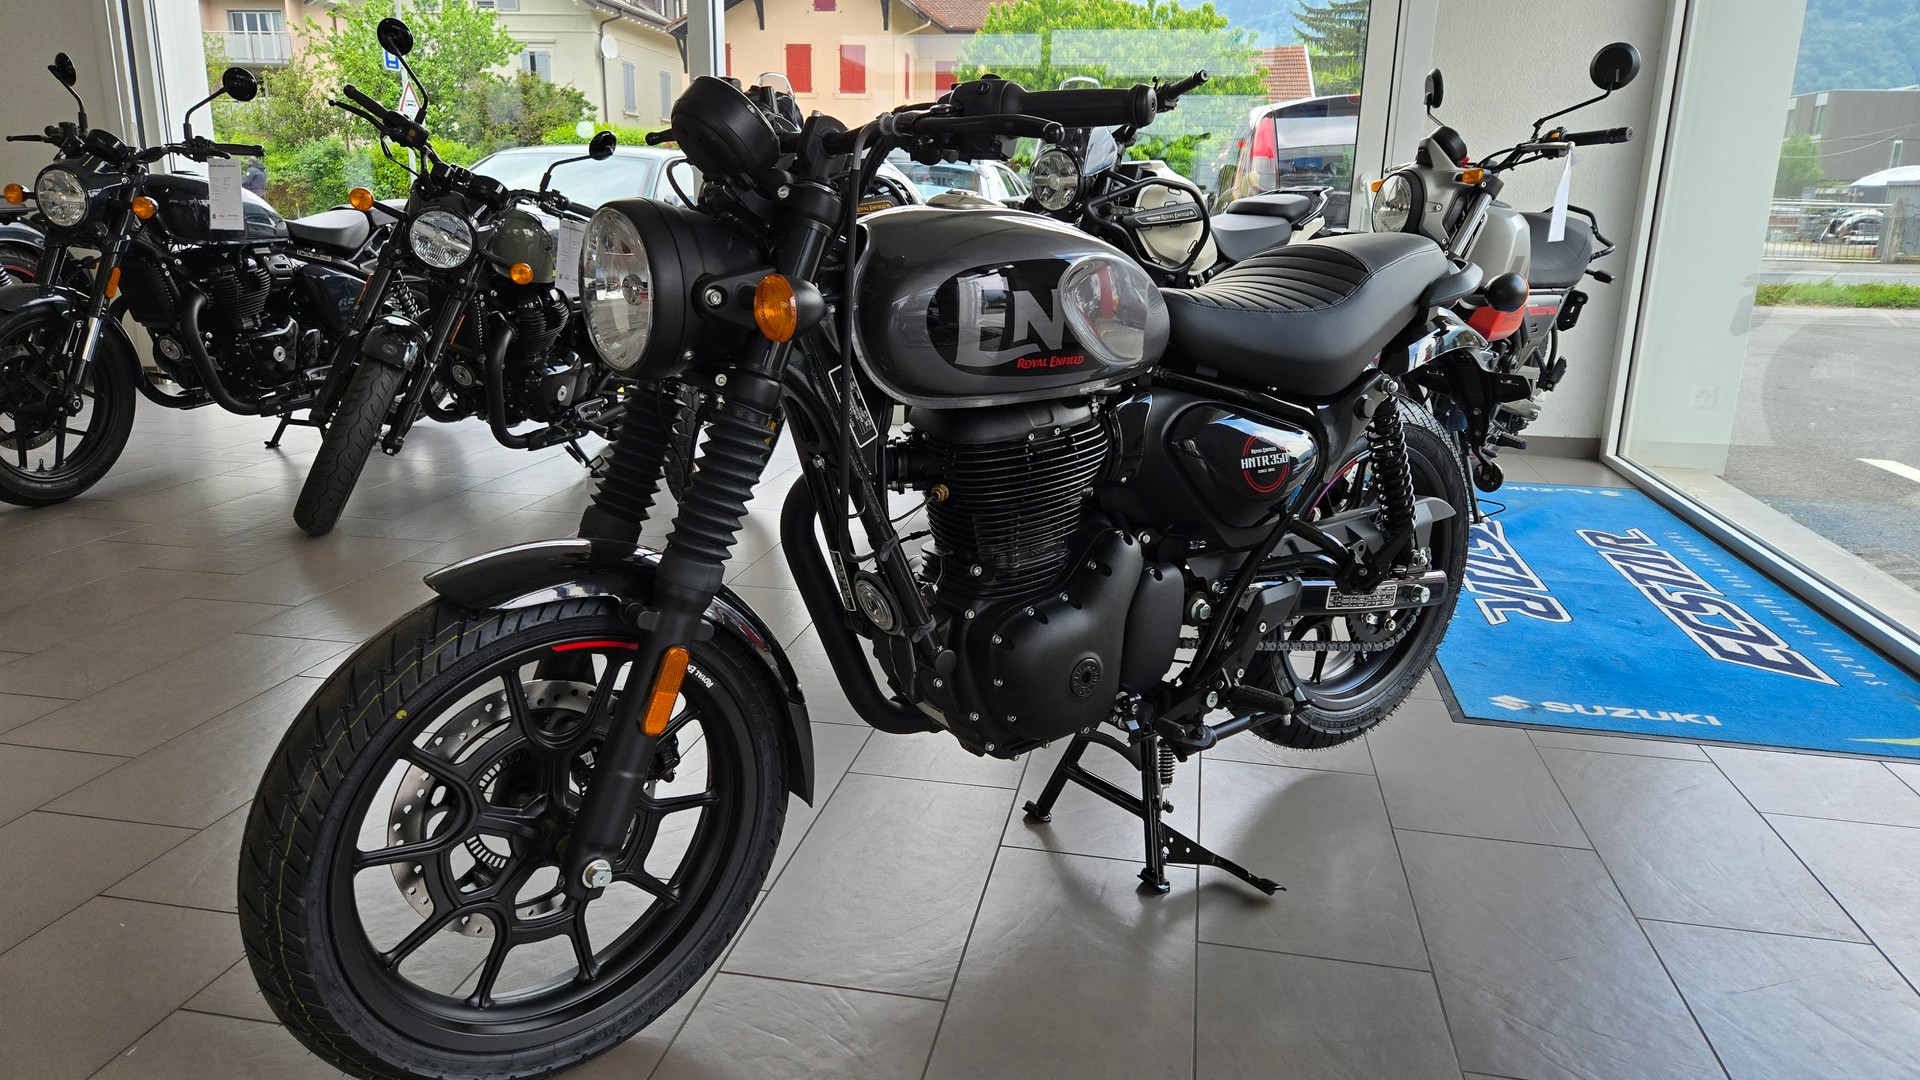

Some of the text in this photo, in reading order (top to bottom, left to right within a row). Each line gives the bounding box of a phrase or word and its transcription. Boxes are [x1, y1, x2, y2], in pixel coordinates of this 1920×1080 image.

[1174, 211, 1189, 219] ENFIELD
[1017, 355, 1085, 369] ROYAL ENFIELD
[1575, 527, 1844, 687] ECSTAR
[1813, 641, 1889, 687] SUZUKI
[694, 669, 714, 689] ROYAL
[1540, 701, 1723, 726] SUZUKI
